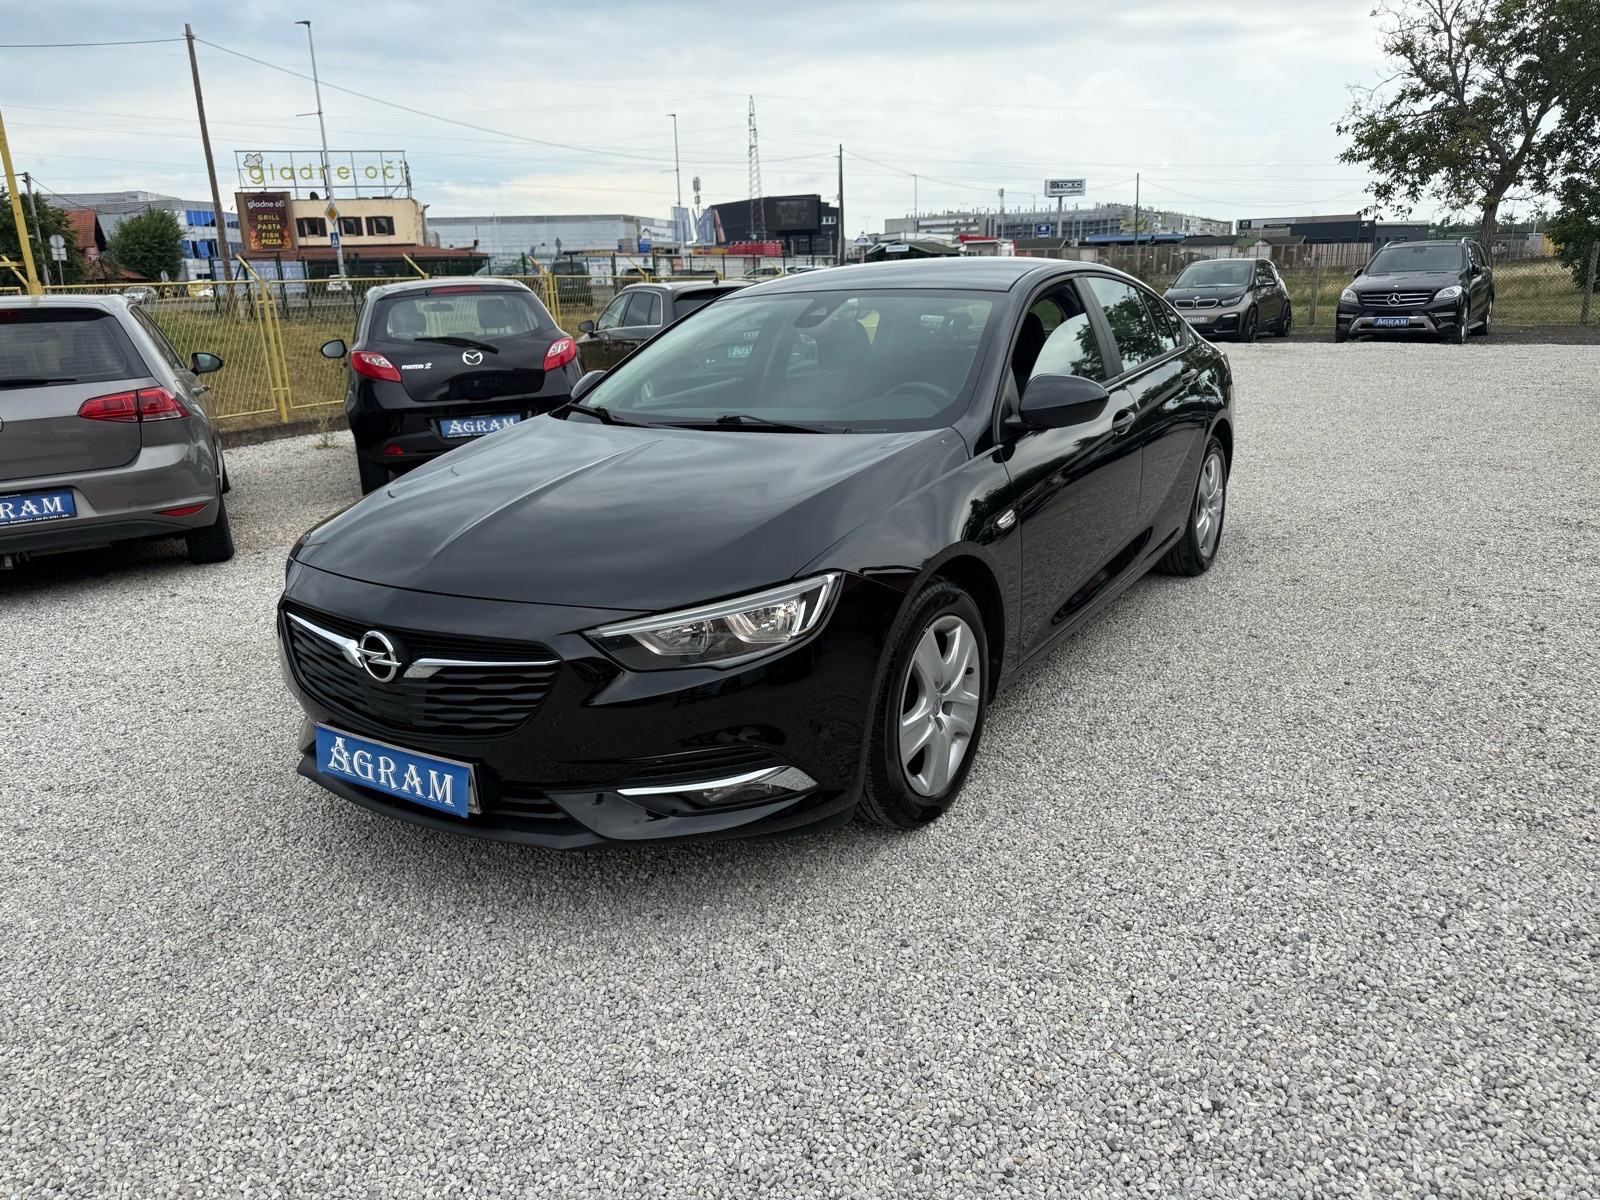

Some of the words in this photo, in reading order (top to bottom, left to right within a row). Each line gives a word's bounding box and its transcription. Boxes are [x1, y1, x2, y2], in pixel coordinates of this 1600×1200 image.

[365, 160, 404, 179] oči
[247, 200, 274, 209] gladne
[448, 417, 514, 434] AGRAM
[327, 736, 455, 807] AGRAM
